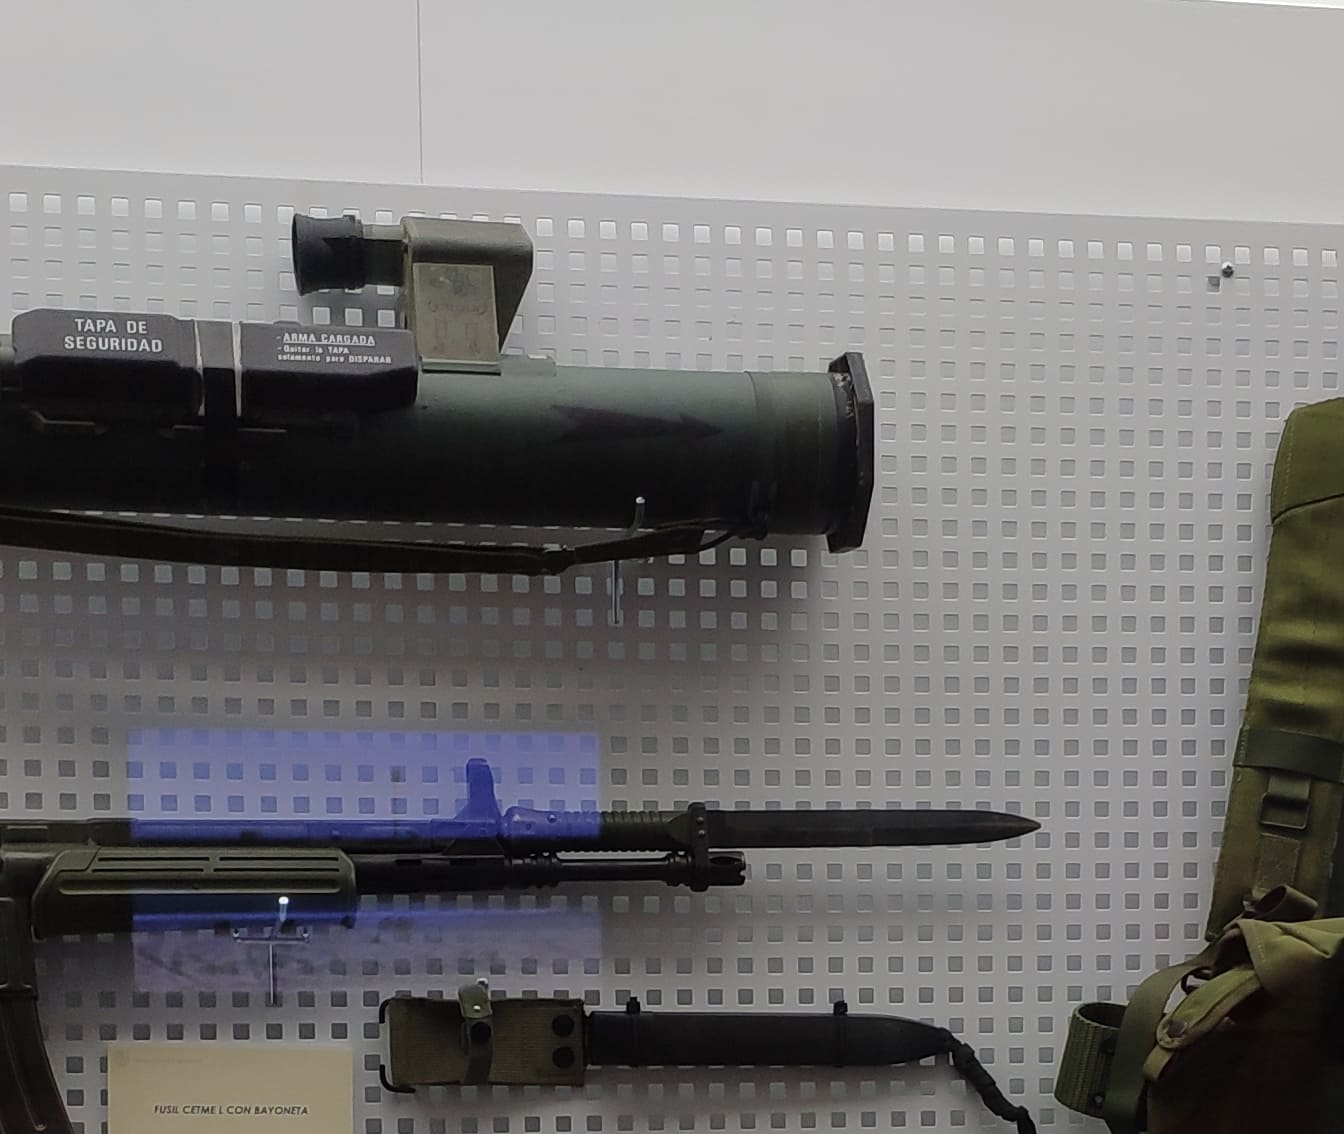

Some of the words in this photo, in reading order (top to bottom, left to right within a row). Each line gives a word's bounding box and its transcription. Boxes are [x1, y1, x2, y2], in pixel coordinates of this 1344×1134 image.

[74, 318, 115, 334] TAPA
[127, 319, 148, 335] DE
[64, 335, 163, 353] SEGURIDAD
[321, 334, 375, 346] CARGADA
[328, 346, 349, 354] TAPA
[349, 356, 392, 364] DISPARAR
[154, 1105, 179, 1115] FUSIL
[182, 1105, 216, 1115] CETME
[226, 1105, 251, 1115] CON
[254, 1106, 308, 1116] BAYONETA
